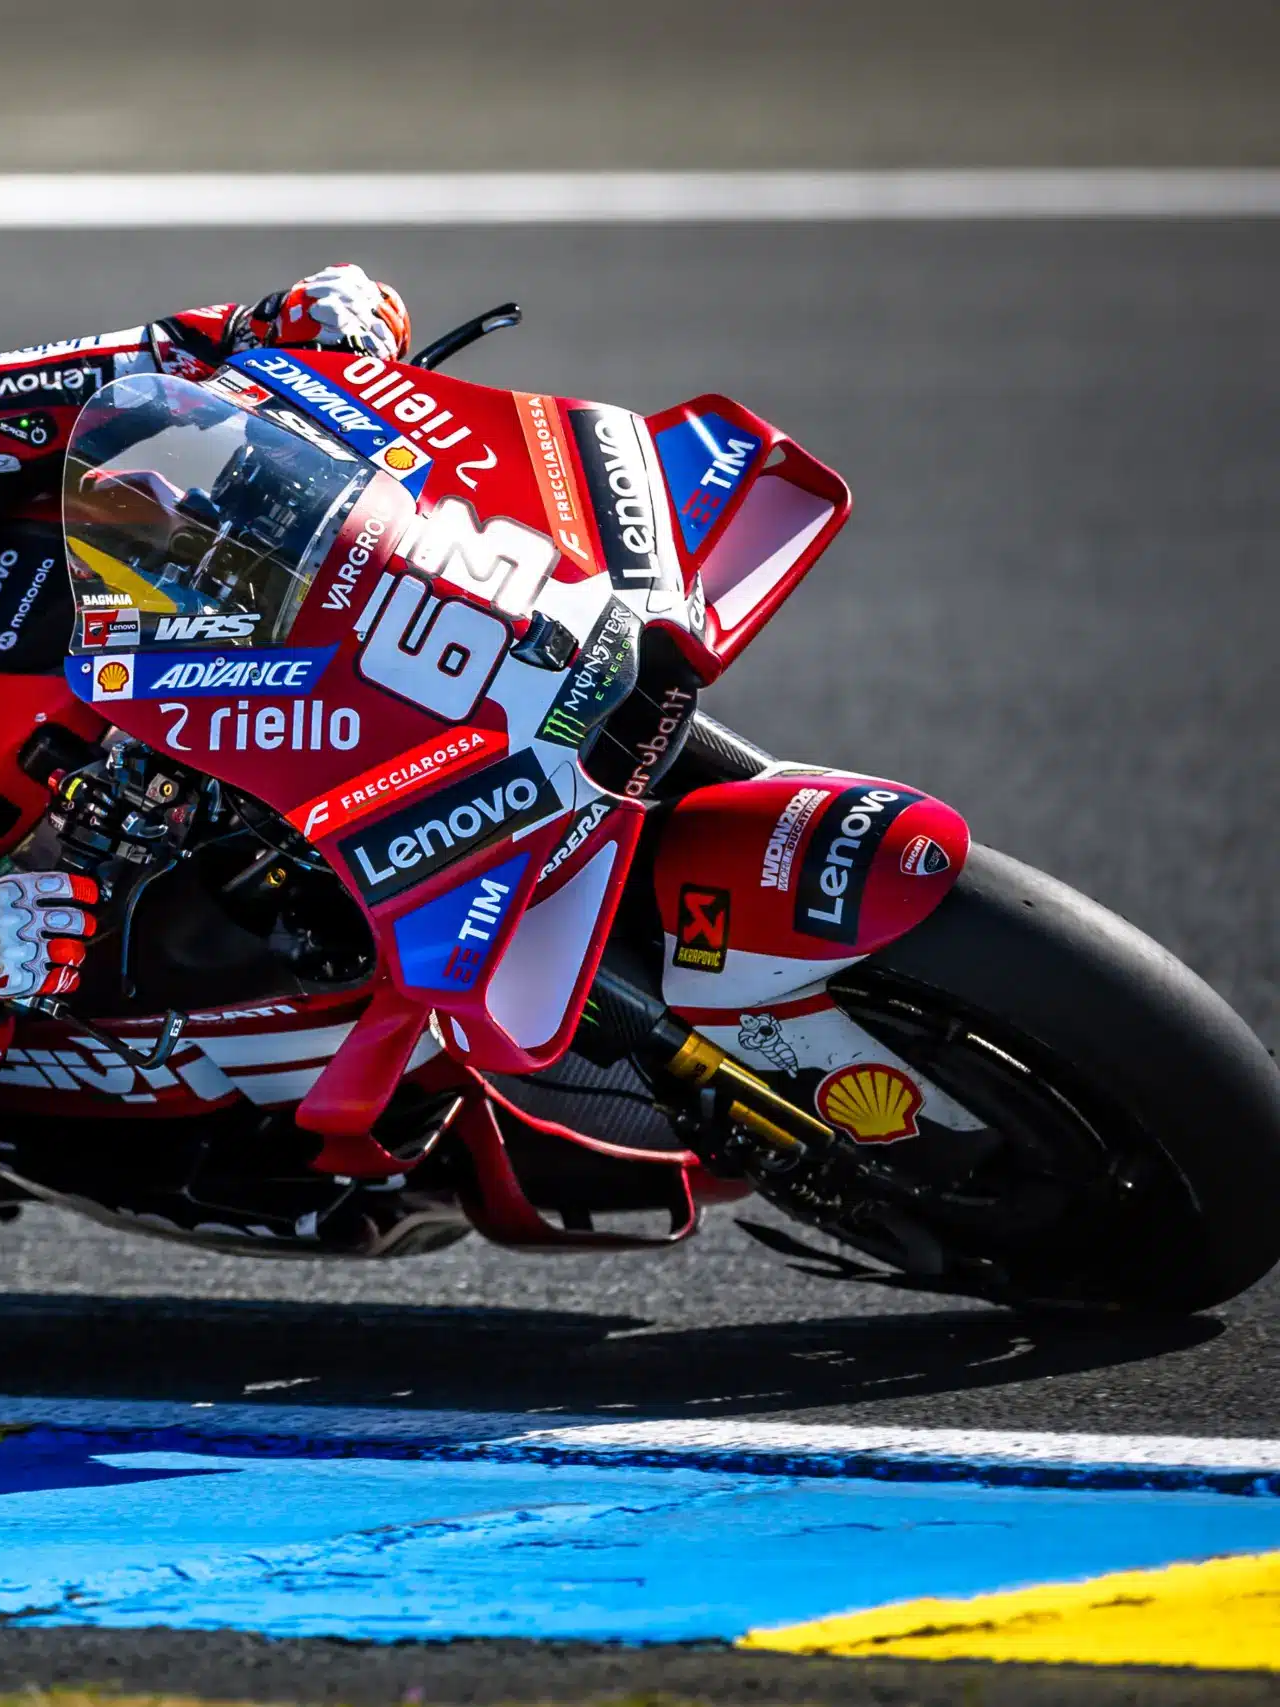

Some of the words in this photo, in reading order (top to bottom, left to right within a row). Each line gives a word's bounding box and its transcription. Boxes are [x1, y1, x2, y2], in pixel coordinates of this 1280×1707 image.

[254, 356, 383, 431] ADVANCE
[343, 356, 472, 449] riello
[528, 397, 575, 522] FRECCIAROSSA
[700, 438, 755, 490] TIM
[595, 418, 663, 580] Lenovo
[11, 558, 55, 628] motorola
[82, 594, 133, 606] BAGNAIA
[109, 623, 136, 632] Lenovo
[155, 614, 261, 640] WRS
[353, 494, 562, 726] 63
[150, 661, 312, 689] ADVANCE
[565, 606, 632, 711] MONSTER
[209, 700, 360, 750] riello
[625, 688, 692, 796] aruba.it
[340, 732, 485, 808] FRECCIAROSSA
[354, 778, 538, 886] Lenovo
[808, 790, 899, 924] Lenovo
[905, 839, 925, 870] DUCATI
[458, 879, 510, 940] TIM
[170, 1018, 183, 1037] 63
